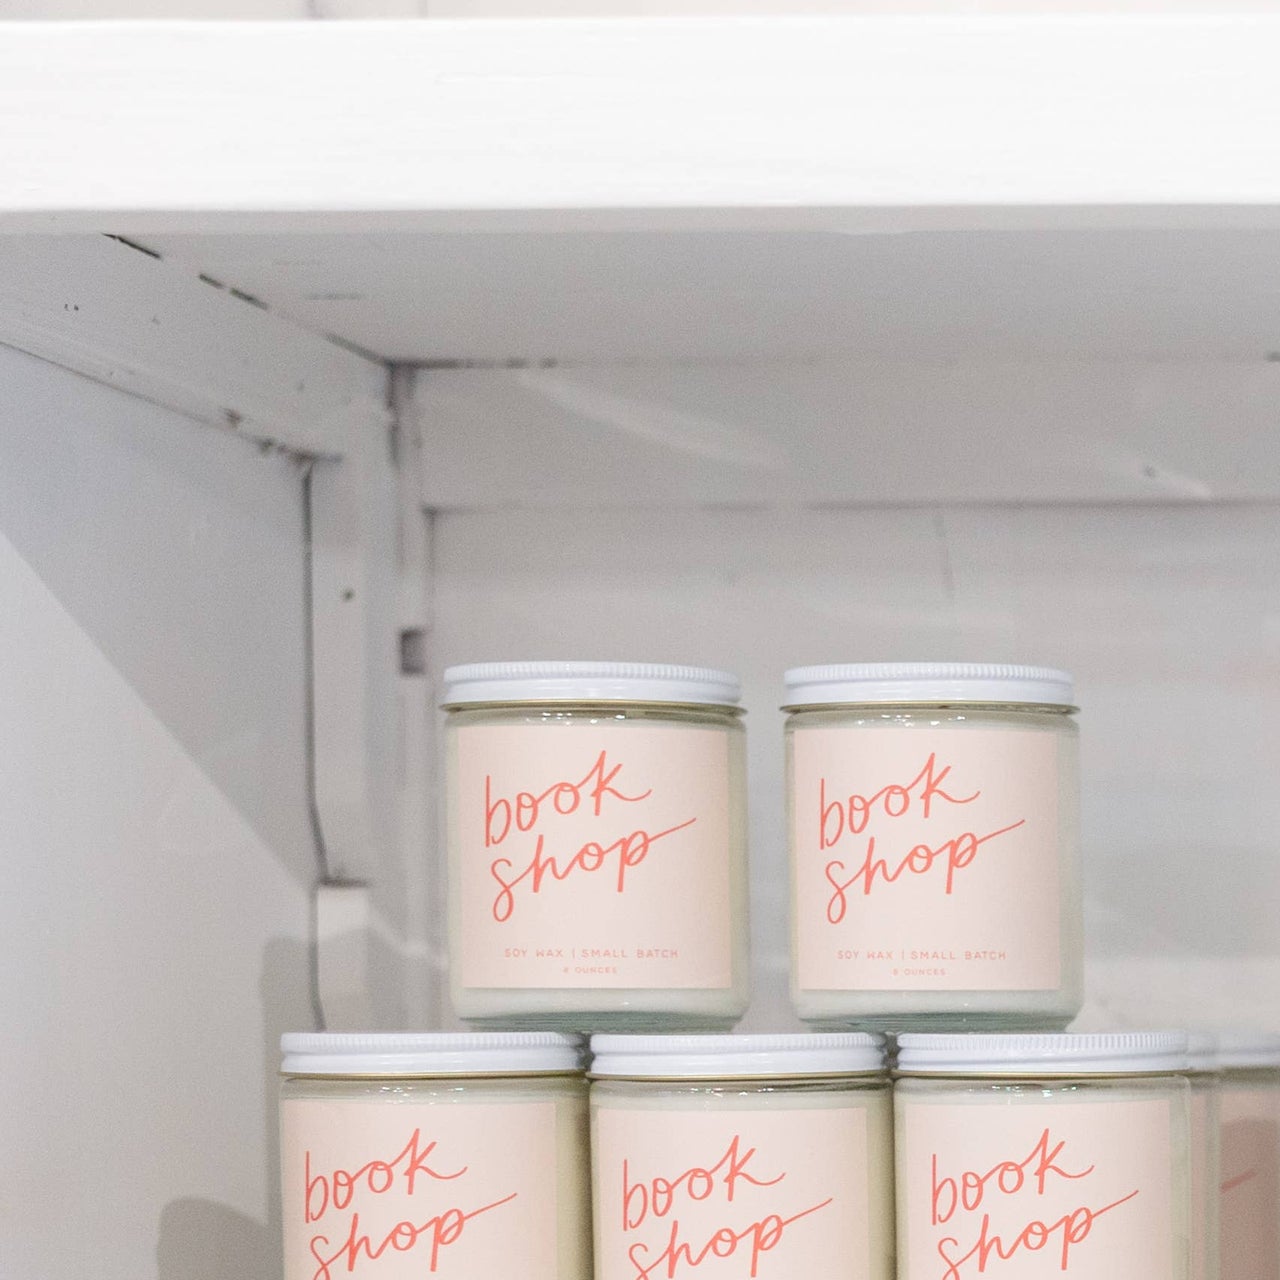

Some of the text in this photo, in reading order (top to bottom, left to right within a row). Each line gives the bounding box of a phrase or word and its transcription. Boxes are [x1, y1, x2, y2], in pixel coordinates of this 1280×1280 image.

[484, 750, 652, 848] book
[819, 752, 980, 851] book
[490, 818, 696, 923] shop
[824, 820, 1025, 924] shop
[503, 948, 680, 959] SOY WAX SMALL BATCH
[574, 966, 618, 974] OUNCES
[836, 950, 1007, 961] SOY WAX SMALL BATCH
[903, 968, 946, 976] OUNCES
[304, 1128, 467, 1224] book
[622, 1135, 785, 1231] book
[931, 1128, 1095, 1226] book
